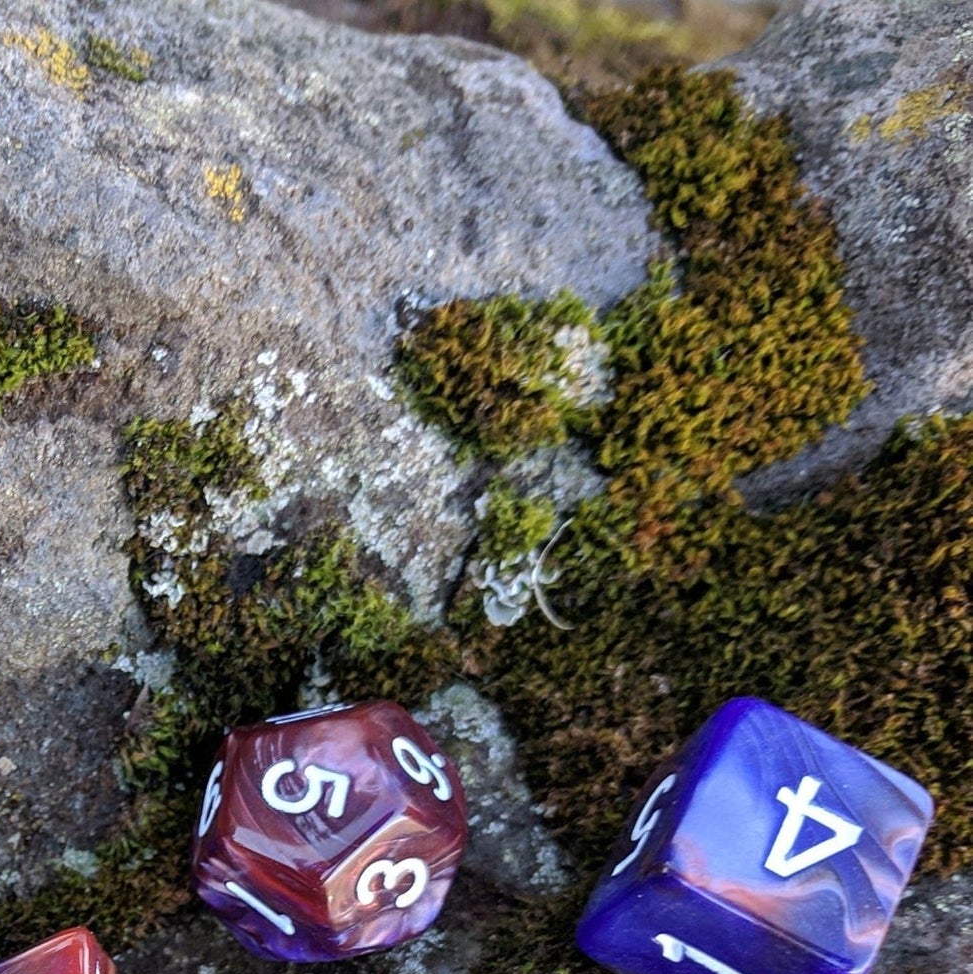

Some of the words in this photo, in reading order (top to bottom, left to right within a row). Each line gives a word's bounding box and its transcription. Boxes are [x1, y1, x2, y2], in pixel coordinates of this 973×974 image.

[261, 758, 351, 819] 5
[611, 773, 677, 877] 5
[764, 775, 864, 878] 4
[225, 880, 296, 936] 1
[356, 857, 428, 909] 3
